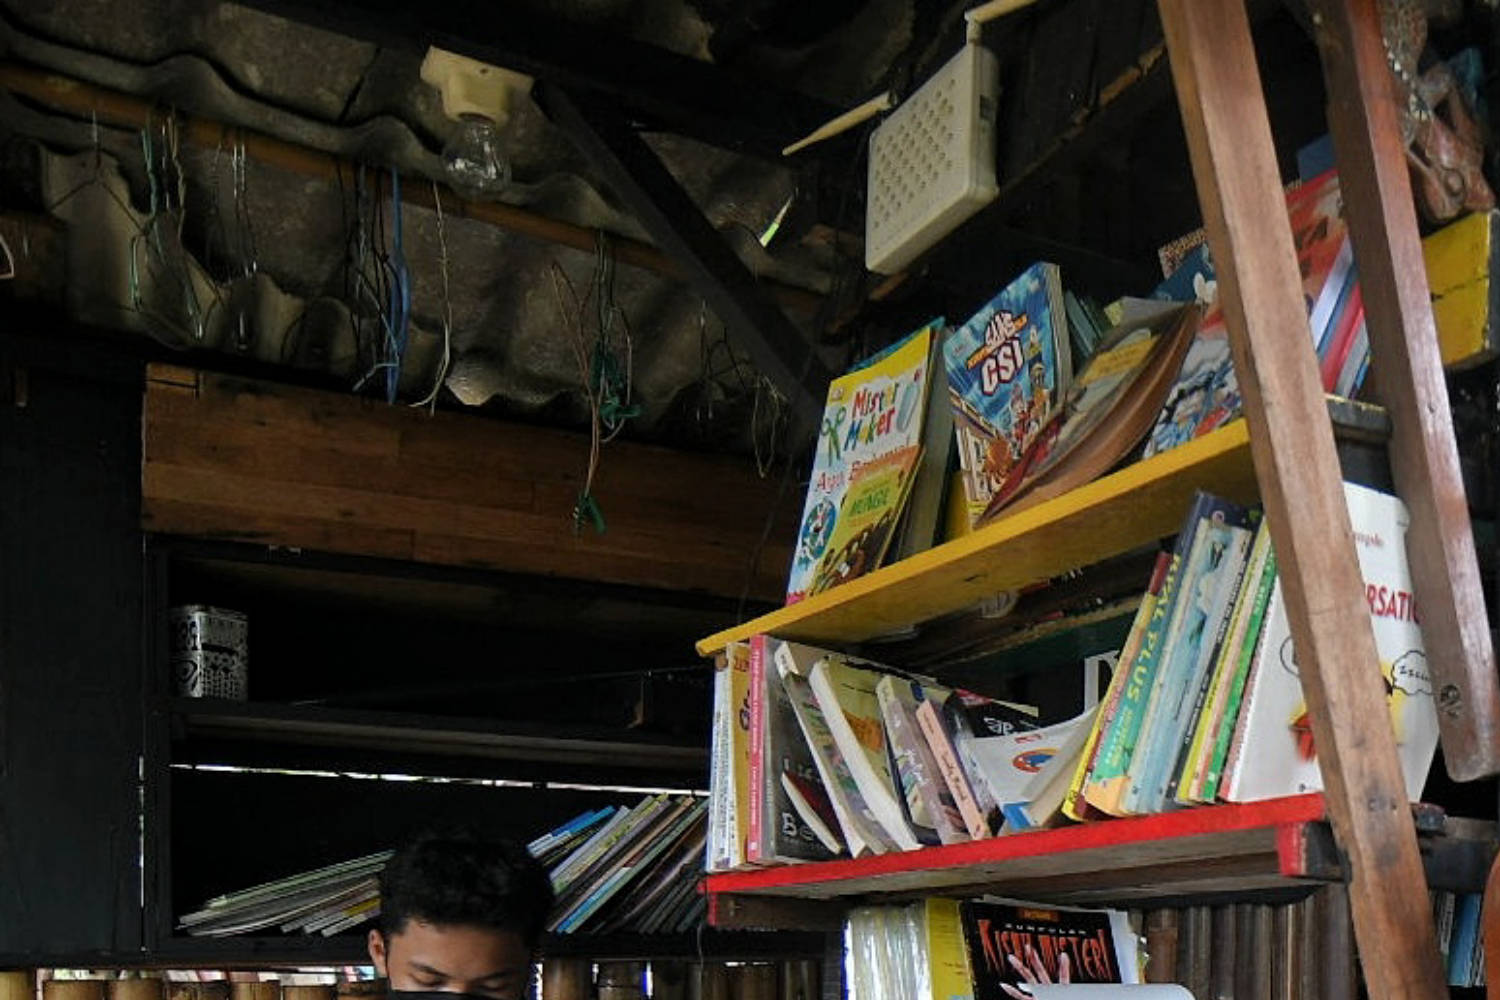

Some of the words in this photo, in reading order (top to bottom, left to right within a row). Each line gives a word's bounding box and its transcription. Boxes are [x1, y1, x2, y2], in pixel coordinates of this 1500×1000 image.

[981, 337, 1025, 396] CSI
[843, 406, 896, 451] Maker
[1127, 631, 1158, 701] PLUS
